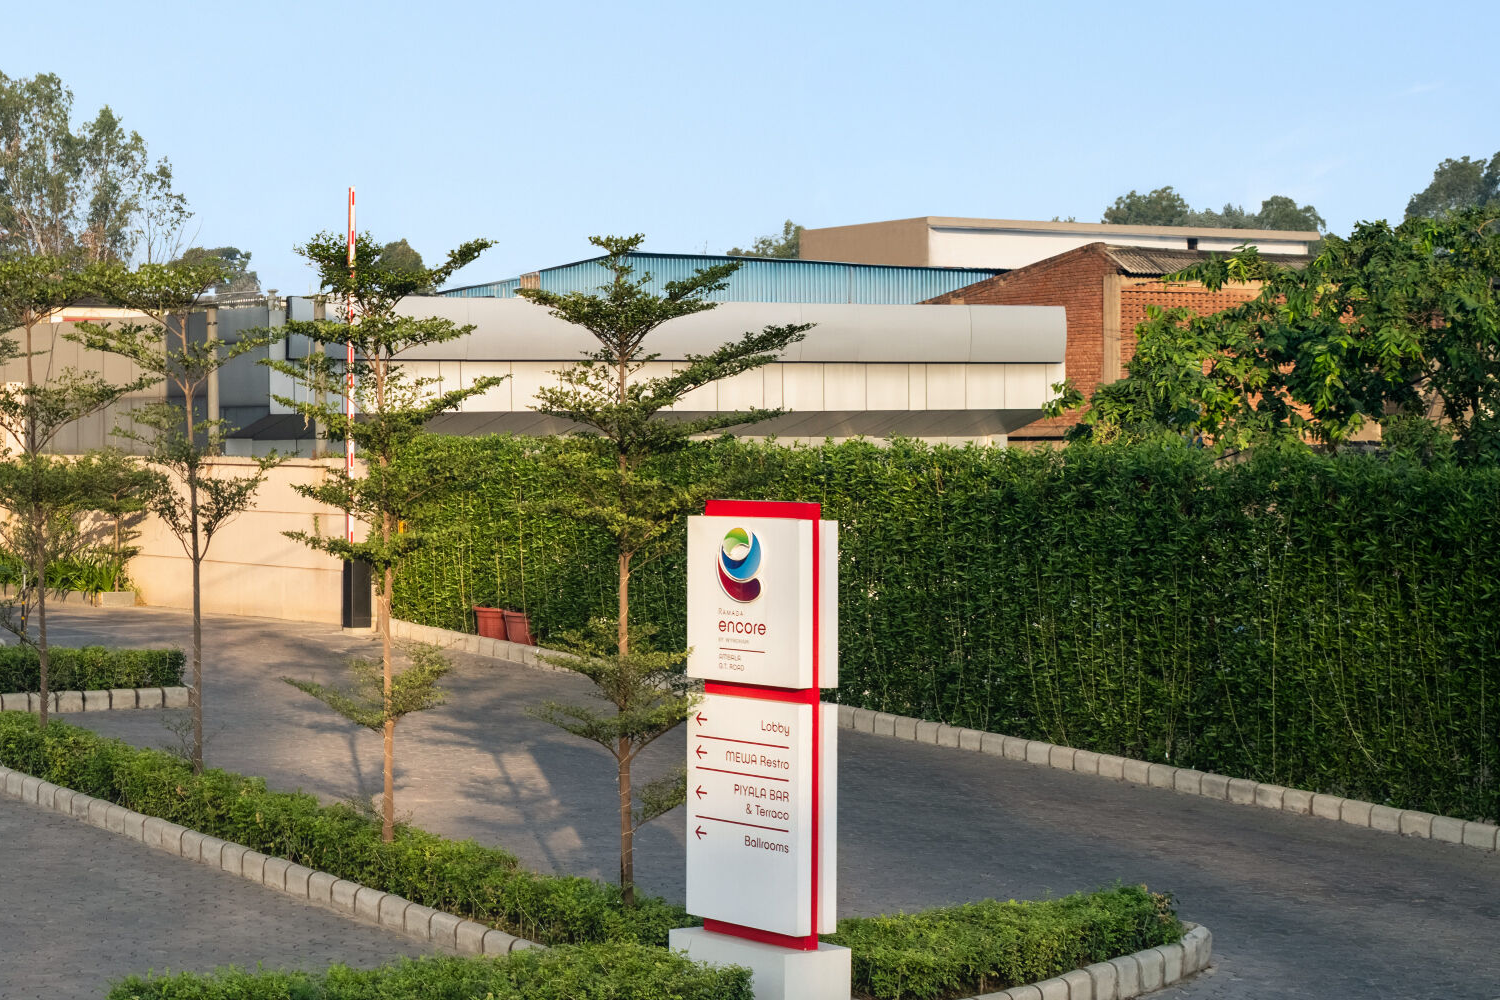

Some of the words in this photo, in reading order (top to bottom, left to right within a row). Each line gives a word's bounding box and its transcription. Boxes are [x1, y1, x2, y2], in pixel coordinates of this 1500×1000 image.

[718, 608, 743, 616] RAMADA
[719, 620, 766, 635] encore
[761, 719, 790, 737] Lobby
[725, 750, 757, 766] MEWA
[760, 755, 790, 770] Restro
[734, 783, 767, 799] PIYALA
[769, 789, 790, 803] BAR
[746, 804, 752, 814] &
[744, 835, 790, 854] Ballrooms
